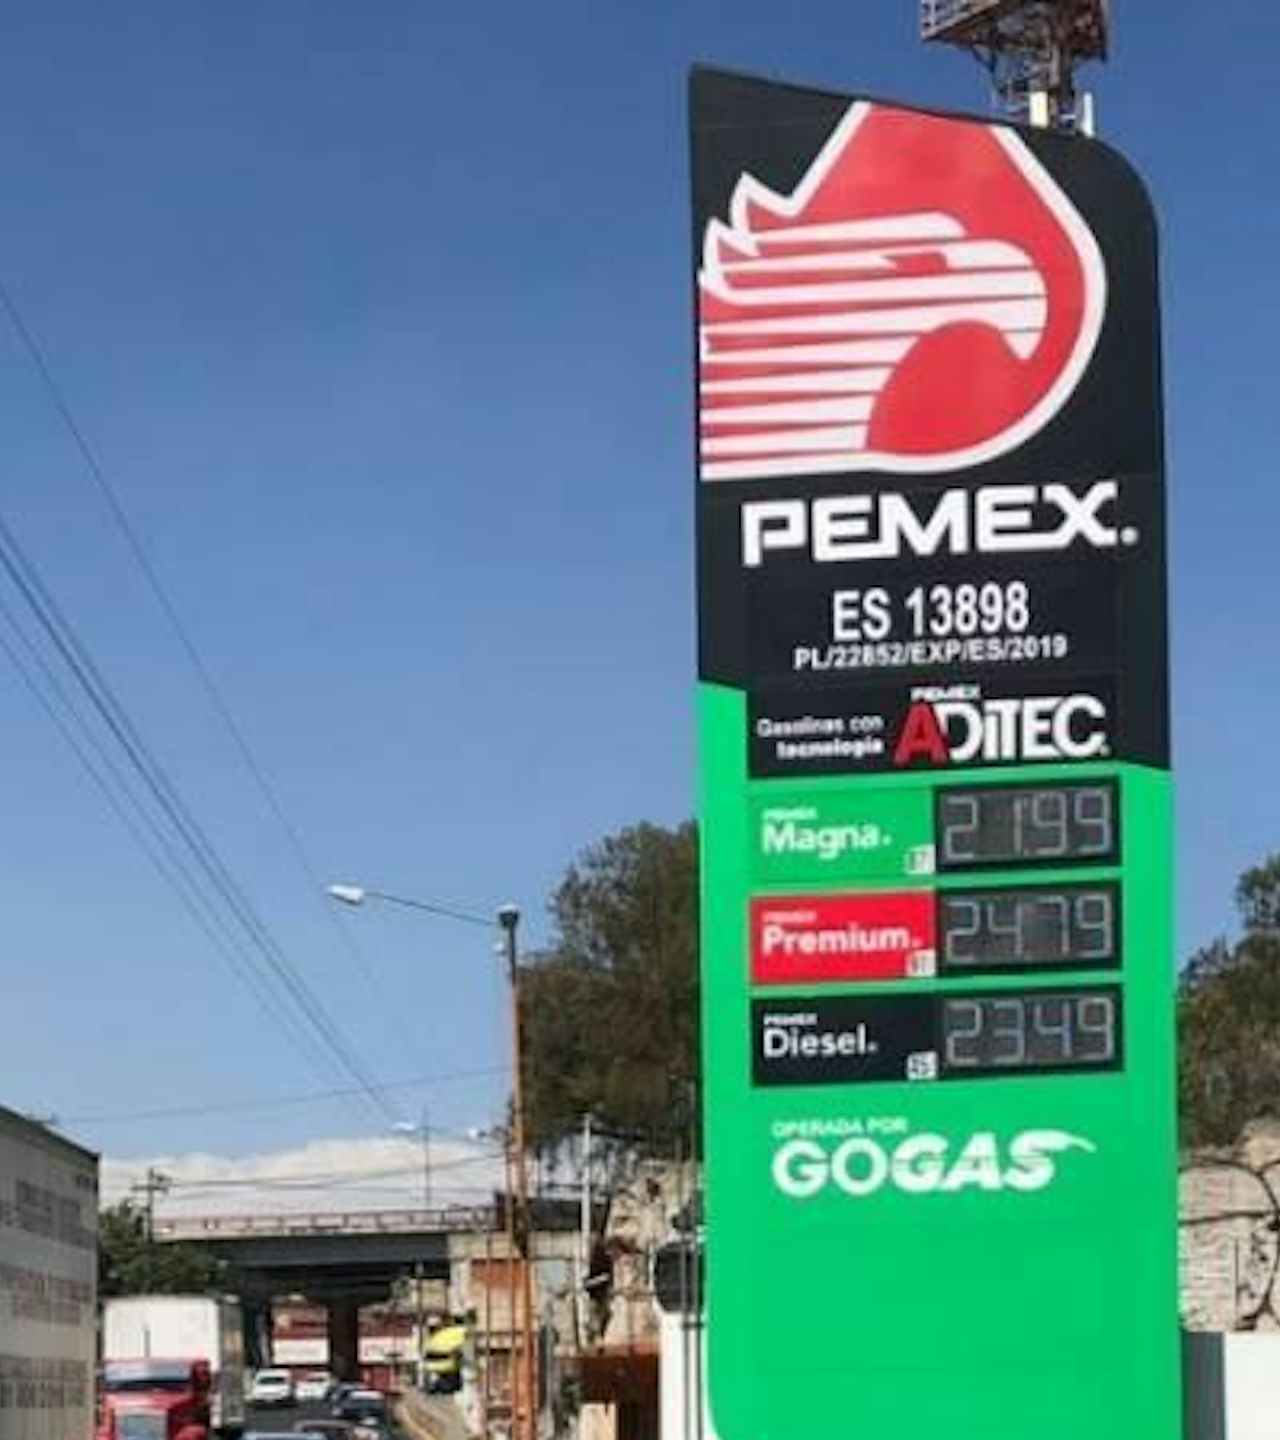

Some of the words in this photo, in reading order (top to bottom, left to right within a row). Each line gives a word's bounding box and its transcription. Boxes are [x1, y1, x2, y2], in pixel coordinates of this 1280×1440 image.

[741, 480, 1119, 568] PEMEX
[832, 587, 891, 641] ES
[904, 581, 1030, 636] 13898
[849, 715, 884, 733] con
[772, 1120, 861, 1138] OPERADA
[867, 1116, 908, 1134] POR
[772, 1129, 1096, 1197] GOGAS
